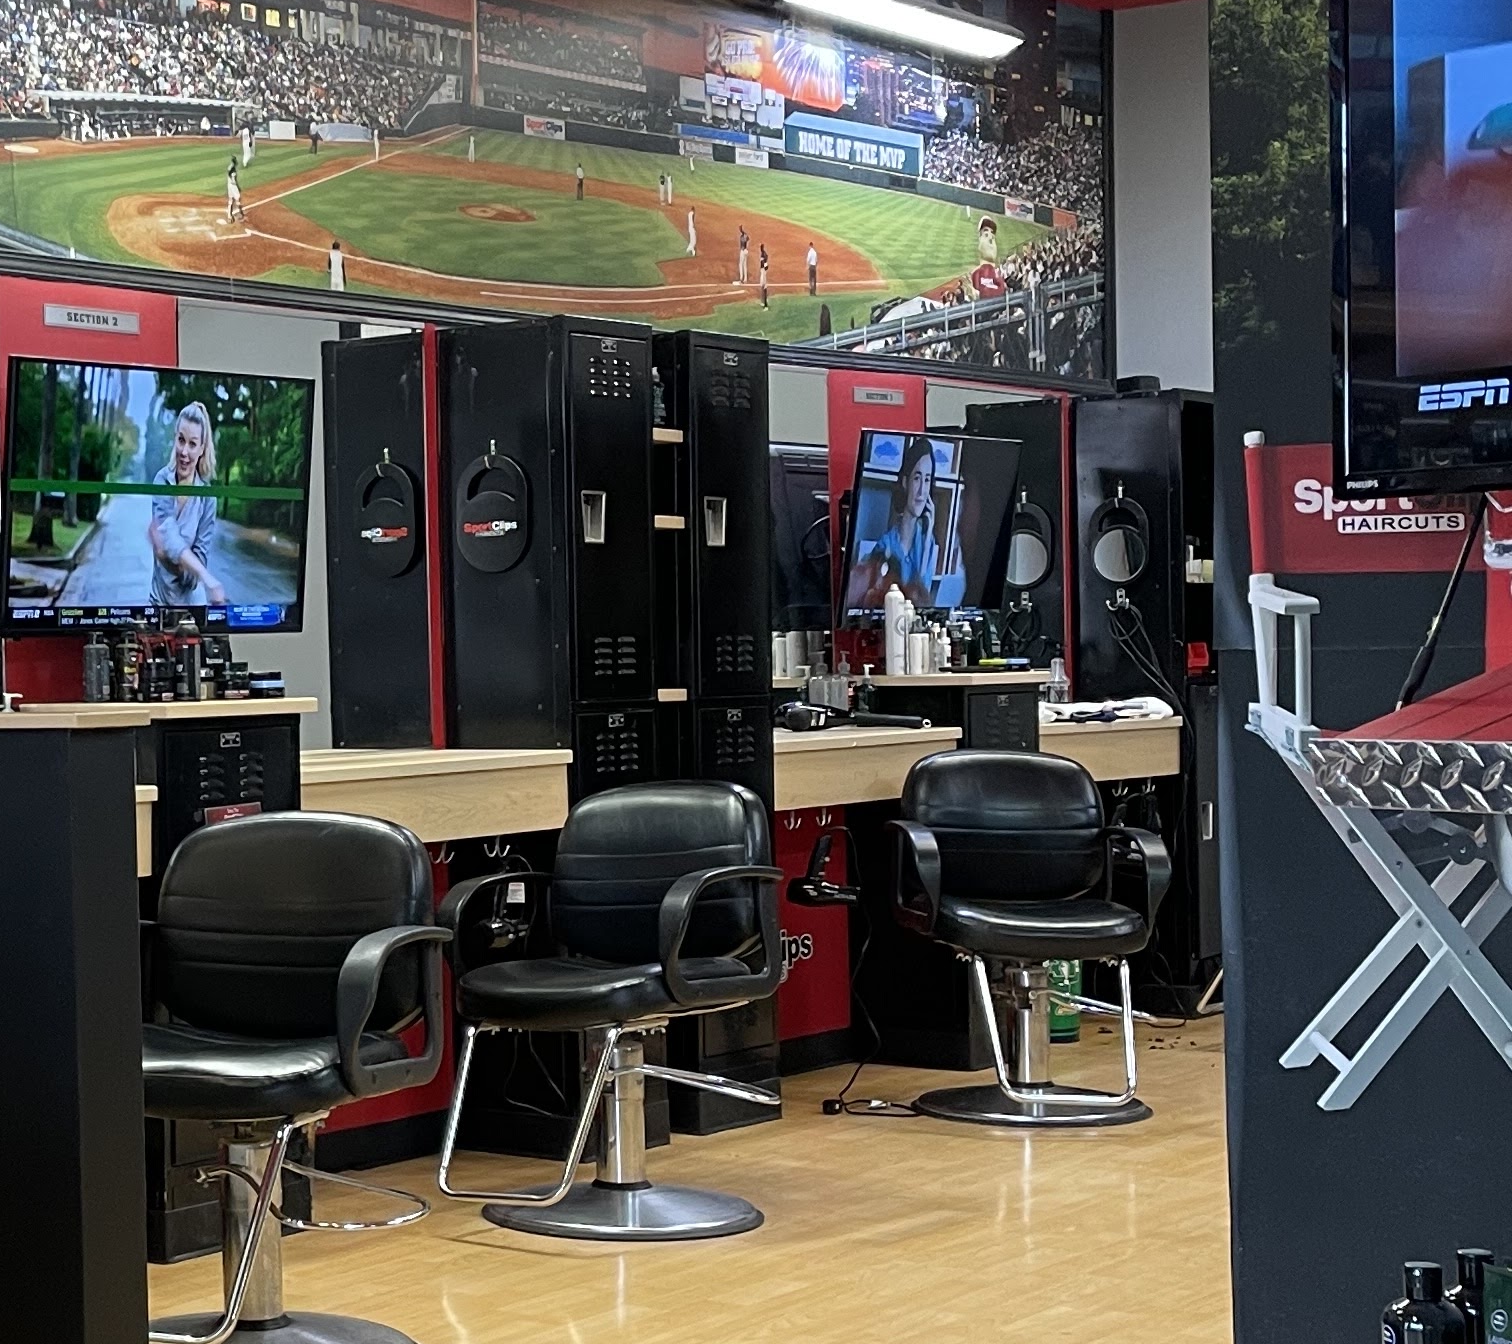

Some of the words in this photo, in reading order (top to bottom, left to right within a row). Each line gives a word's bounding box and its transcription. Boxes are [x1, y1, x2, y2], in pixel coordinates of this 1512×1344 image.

[798, 131, 834, 158] HOME
[836, 137, 852, 161] OF
[853, 141, 878, 166] THE
[879, 145, 906, 170] MVP
[66, 311, 110, 326] SECTION
[112, 316, 119, 327] 2
[1418, 377, 1510, 412] ESPN
[463, 520, 518, 537] SportClips
[1341, 515, 1461, 532] HAIRCUTS
